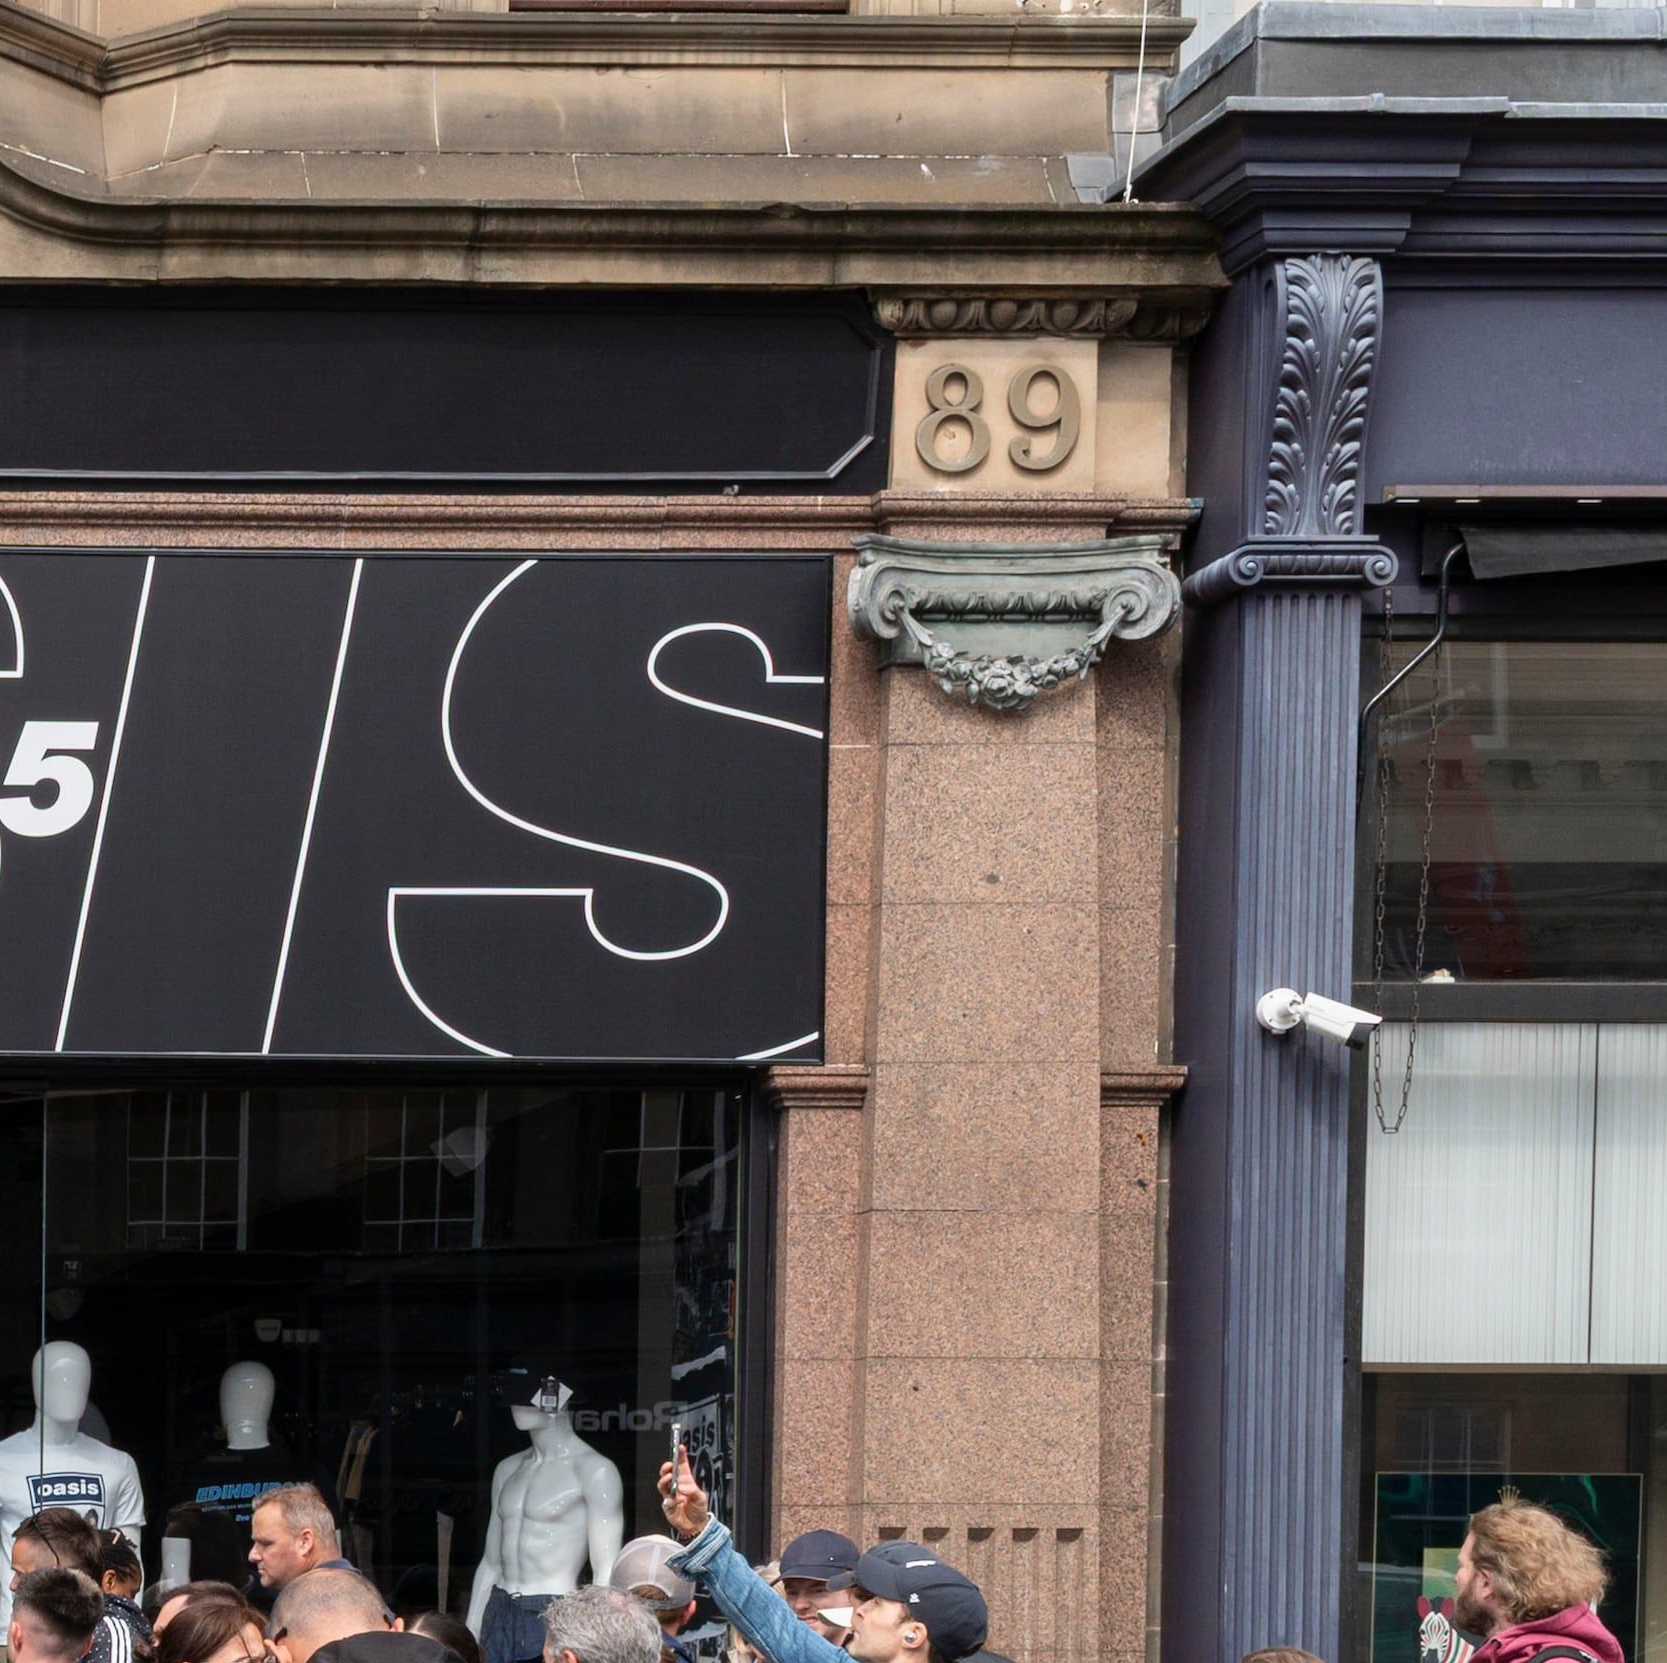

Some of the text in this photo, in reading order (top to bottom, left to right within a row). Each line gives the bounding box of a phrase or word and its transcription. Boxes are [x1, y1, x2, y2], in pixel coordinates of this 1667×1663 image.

[916, 363, 1081, 472] 89
[37, 1479, 99, 1497] oasis
[195, 1482, 310, 1503] EDINBUR
